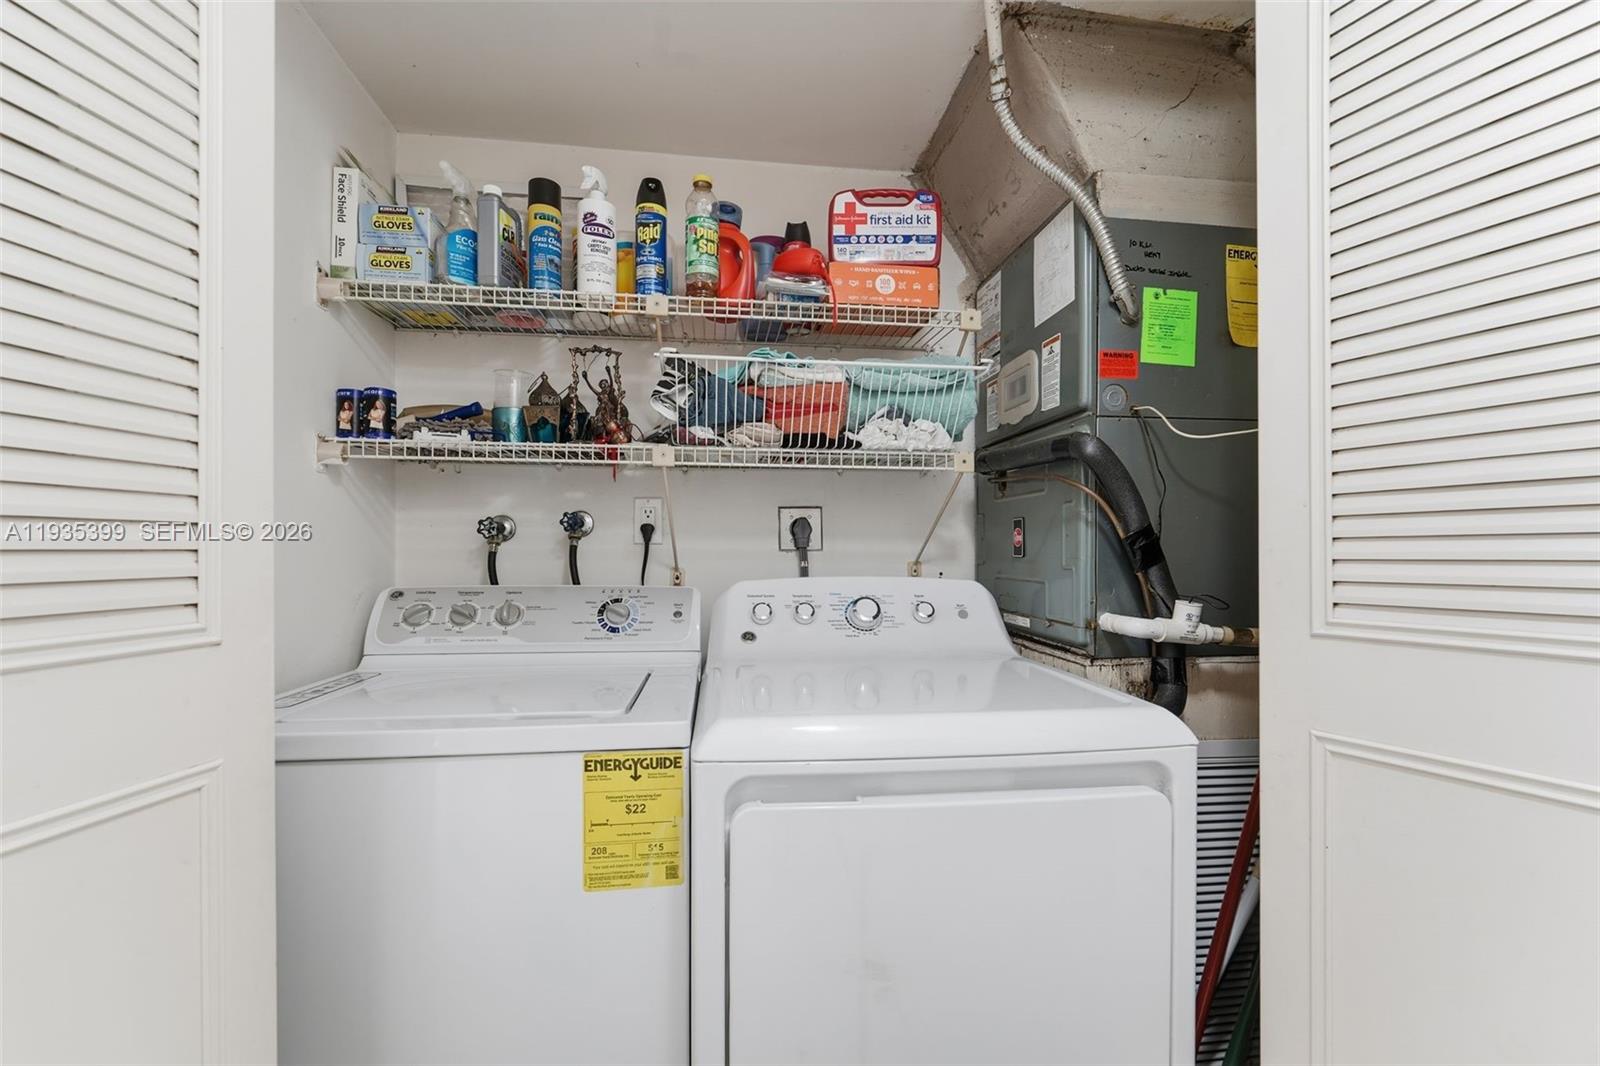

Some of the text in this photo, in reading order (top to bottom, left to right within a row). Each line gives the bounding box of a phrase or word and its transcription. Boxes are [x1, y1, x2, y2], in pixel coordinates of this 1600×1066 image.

[337, 173, 347, 223] Face Shield
[870, 214, 931, 224] first aid kit
[374, 220, 412, 230] GLOVES
[585, 226, 612, 236] FOLEX
[638, 224, 660, 242] Raid
[370, 259, 410, 269] GLOVES
[584, 756, 682, 772] ENERGYGUIDE
[625, 804, 646, 815] $22
[592, 847, 608, 856] 208
